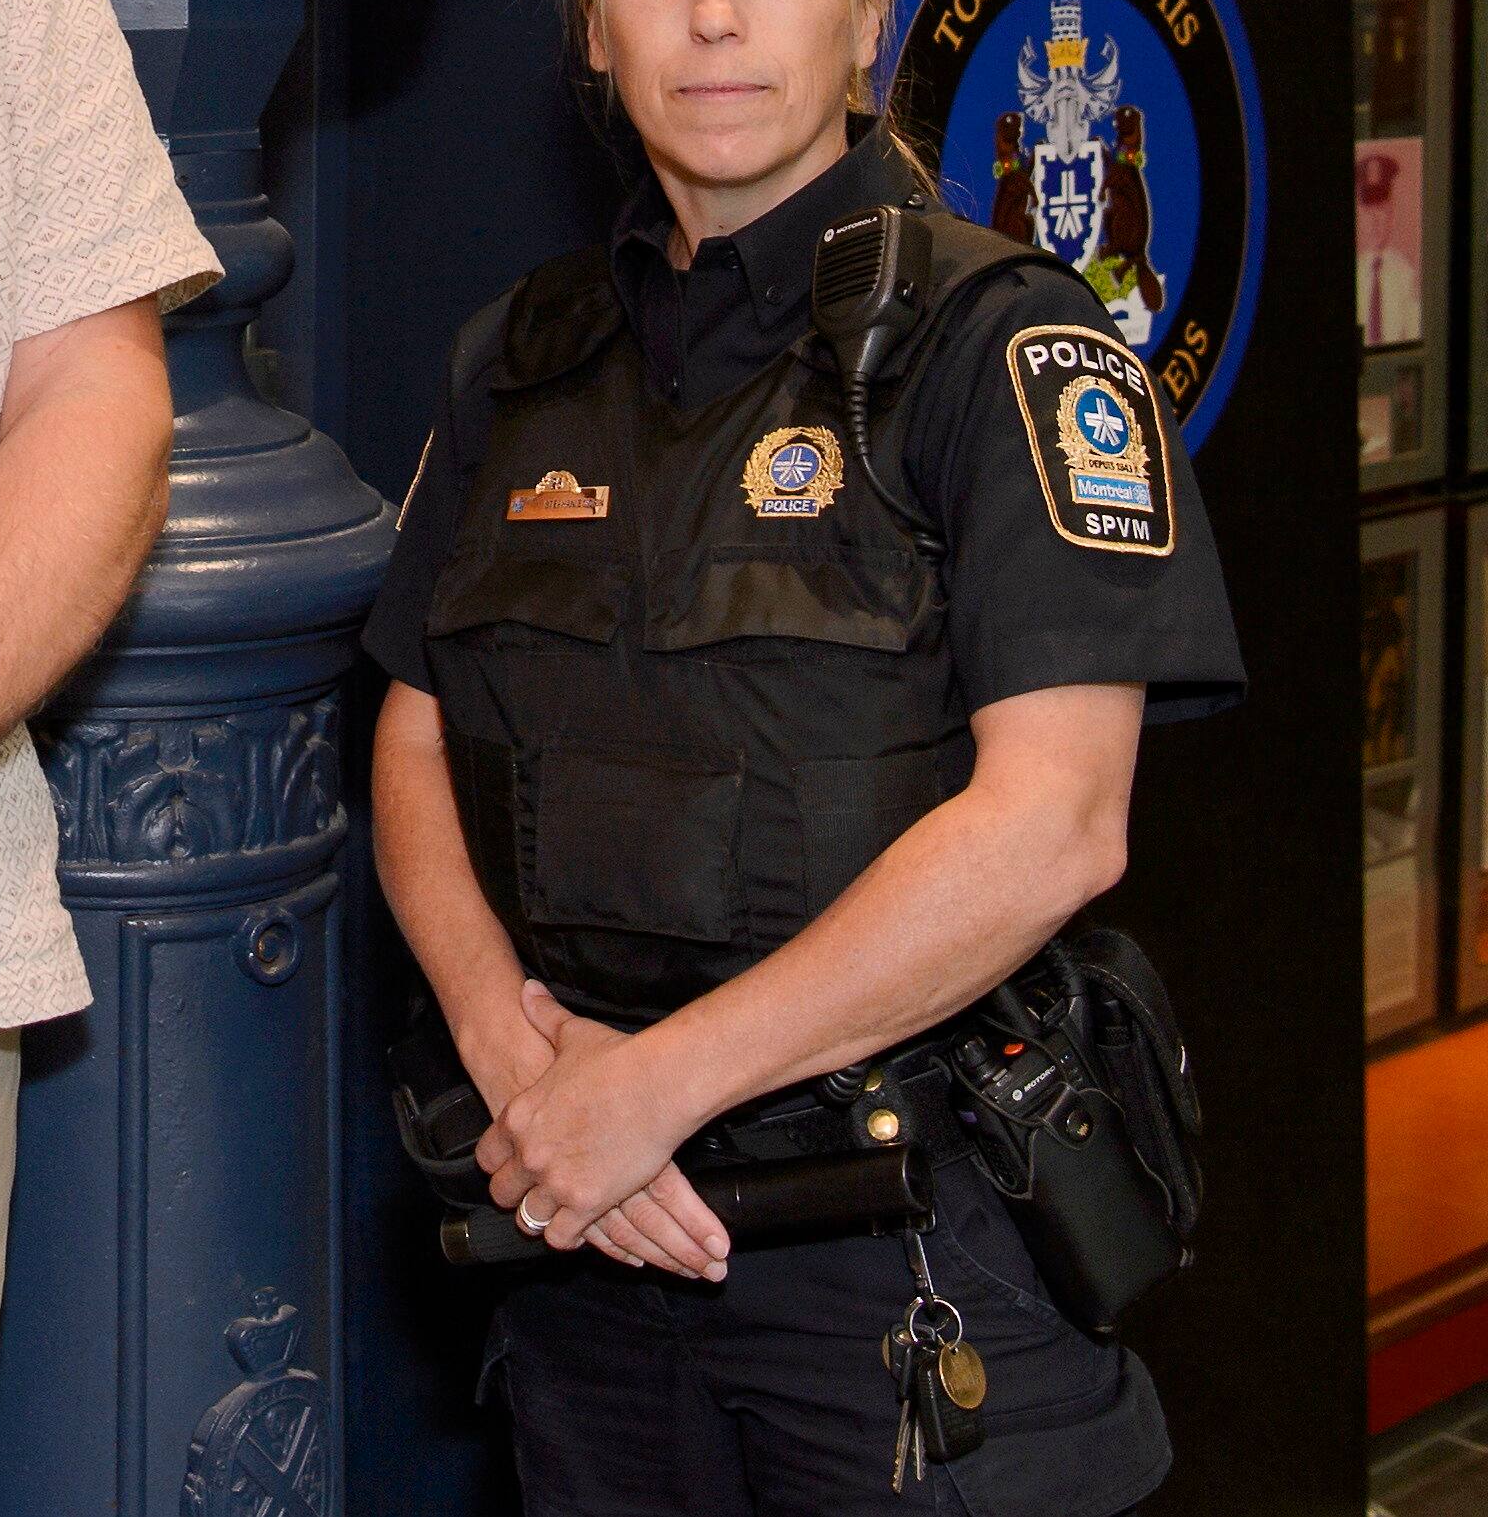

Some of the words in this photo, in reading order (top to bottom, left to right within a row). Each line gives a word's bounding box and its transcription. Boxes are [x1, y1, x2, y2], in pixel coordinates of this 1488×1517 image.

[1023, 341, 1145, 396] POLICE
[764, 500, 811, 512] POLICE
[1085, 512, 1150, 541] SPVM
